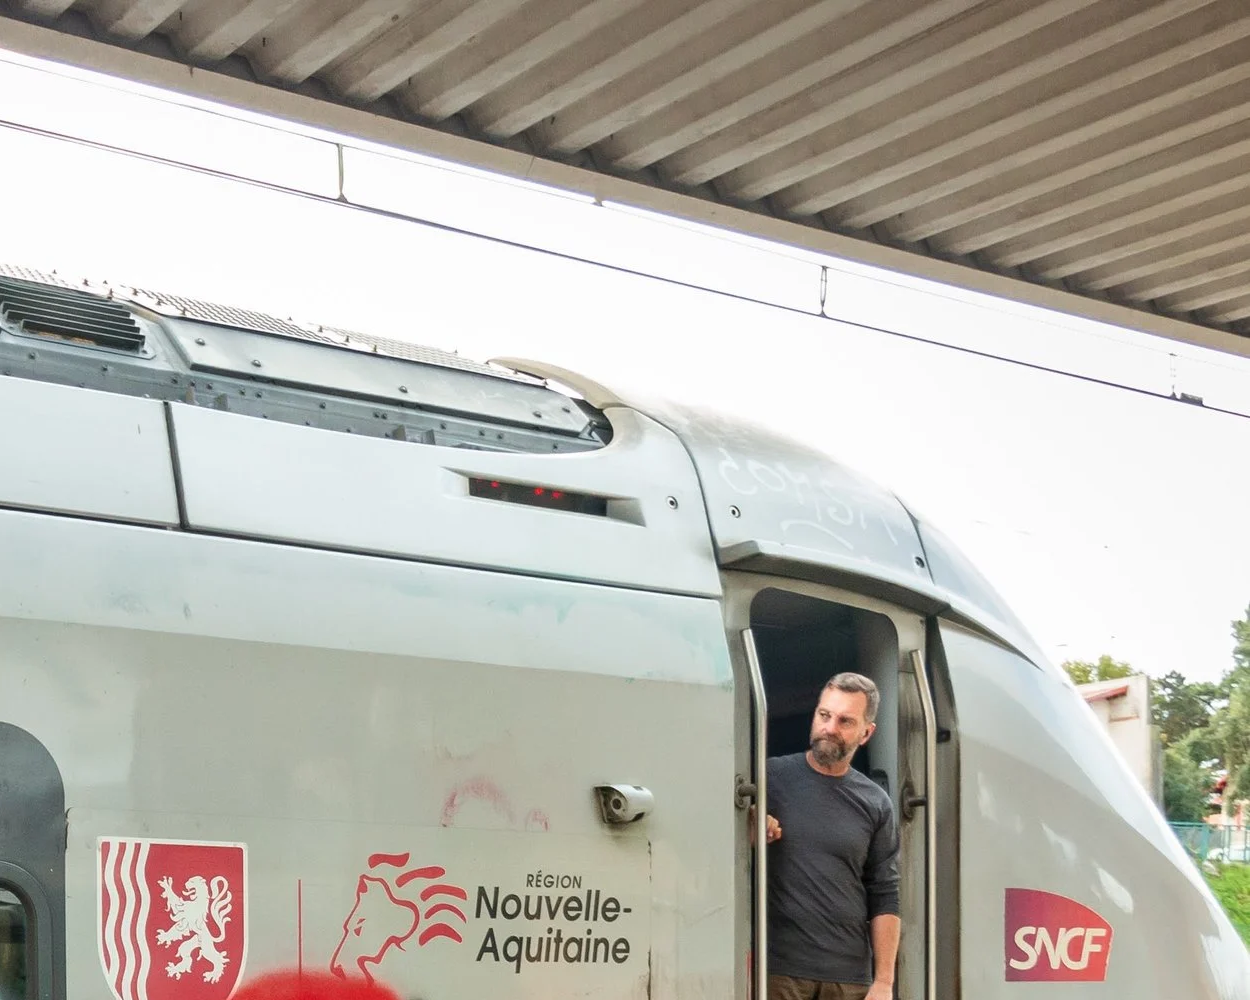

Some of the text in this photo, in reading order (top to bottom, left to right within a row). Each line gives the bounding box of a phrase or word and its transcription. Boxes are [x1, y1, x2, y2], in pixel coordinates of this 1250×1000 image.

[526, 870, 582, 888] RÉGION
[475, 886, 632, 922] Nouvelle-
[475, 927, 631, 974] Aquitaine
[1008, 926, 1107, 971] SNCF
